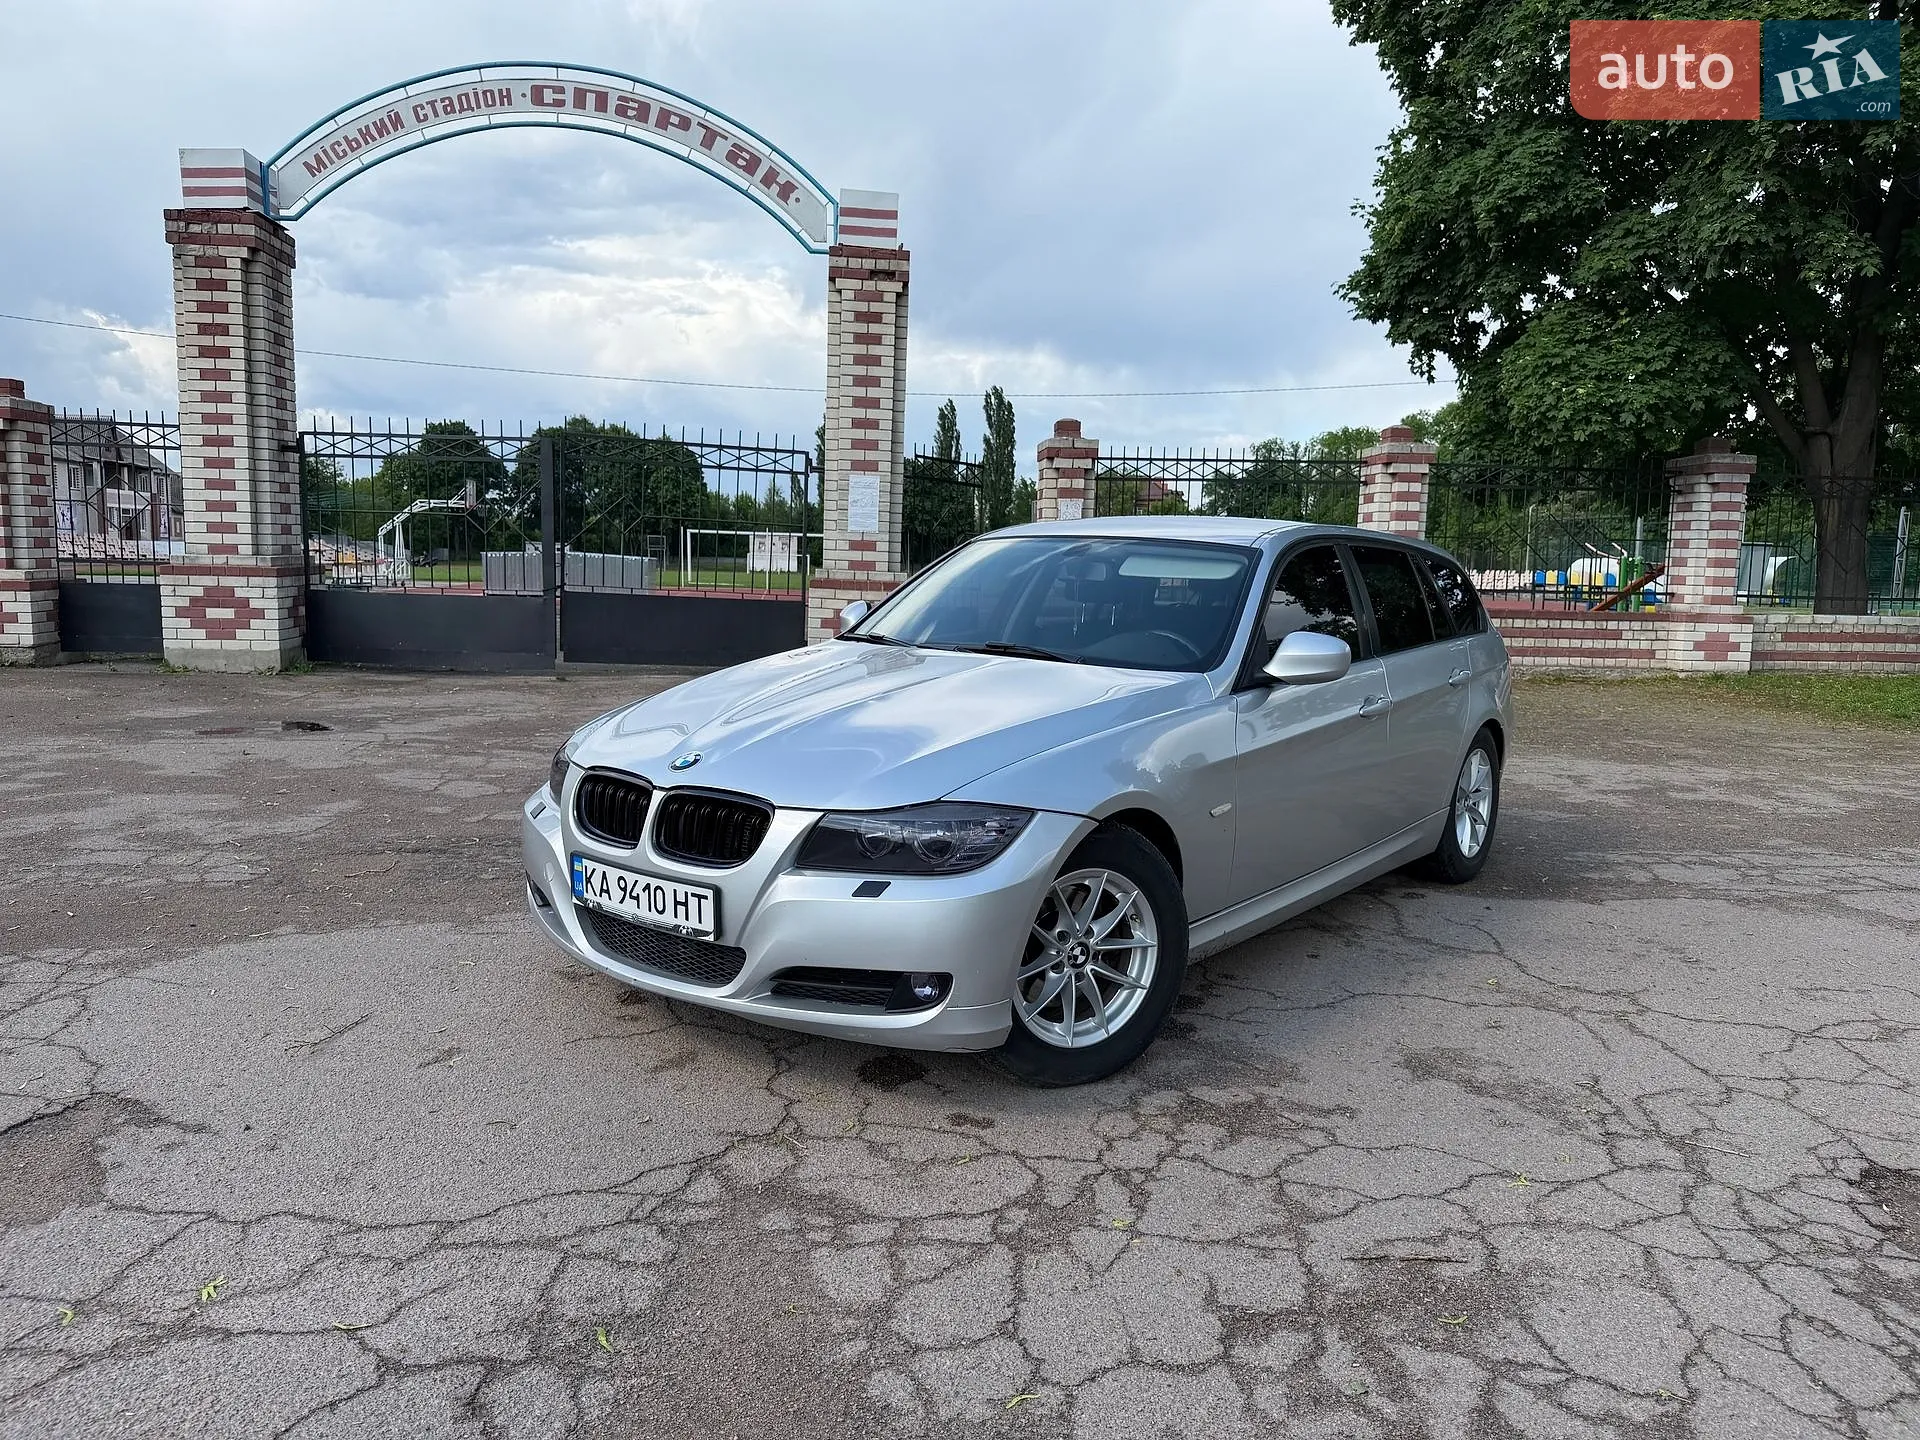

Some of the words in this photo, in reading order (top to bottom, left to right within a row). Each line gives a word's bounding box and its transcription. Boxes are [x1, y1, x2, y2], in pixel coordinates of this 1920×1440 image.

[574, 880, 583, 891] UA
[584, 865, 612, 901] KA
[617, 875, 666, 915] 9410
[673, 888, 709, 925] HT
